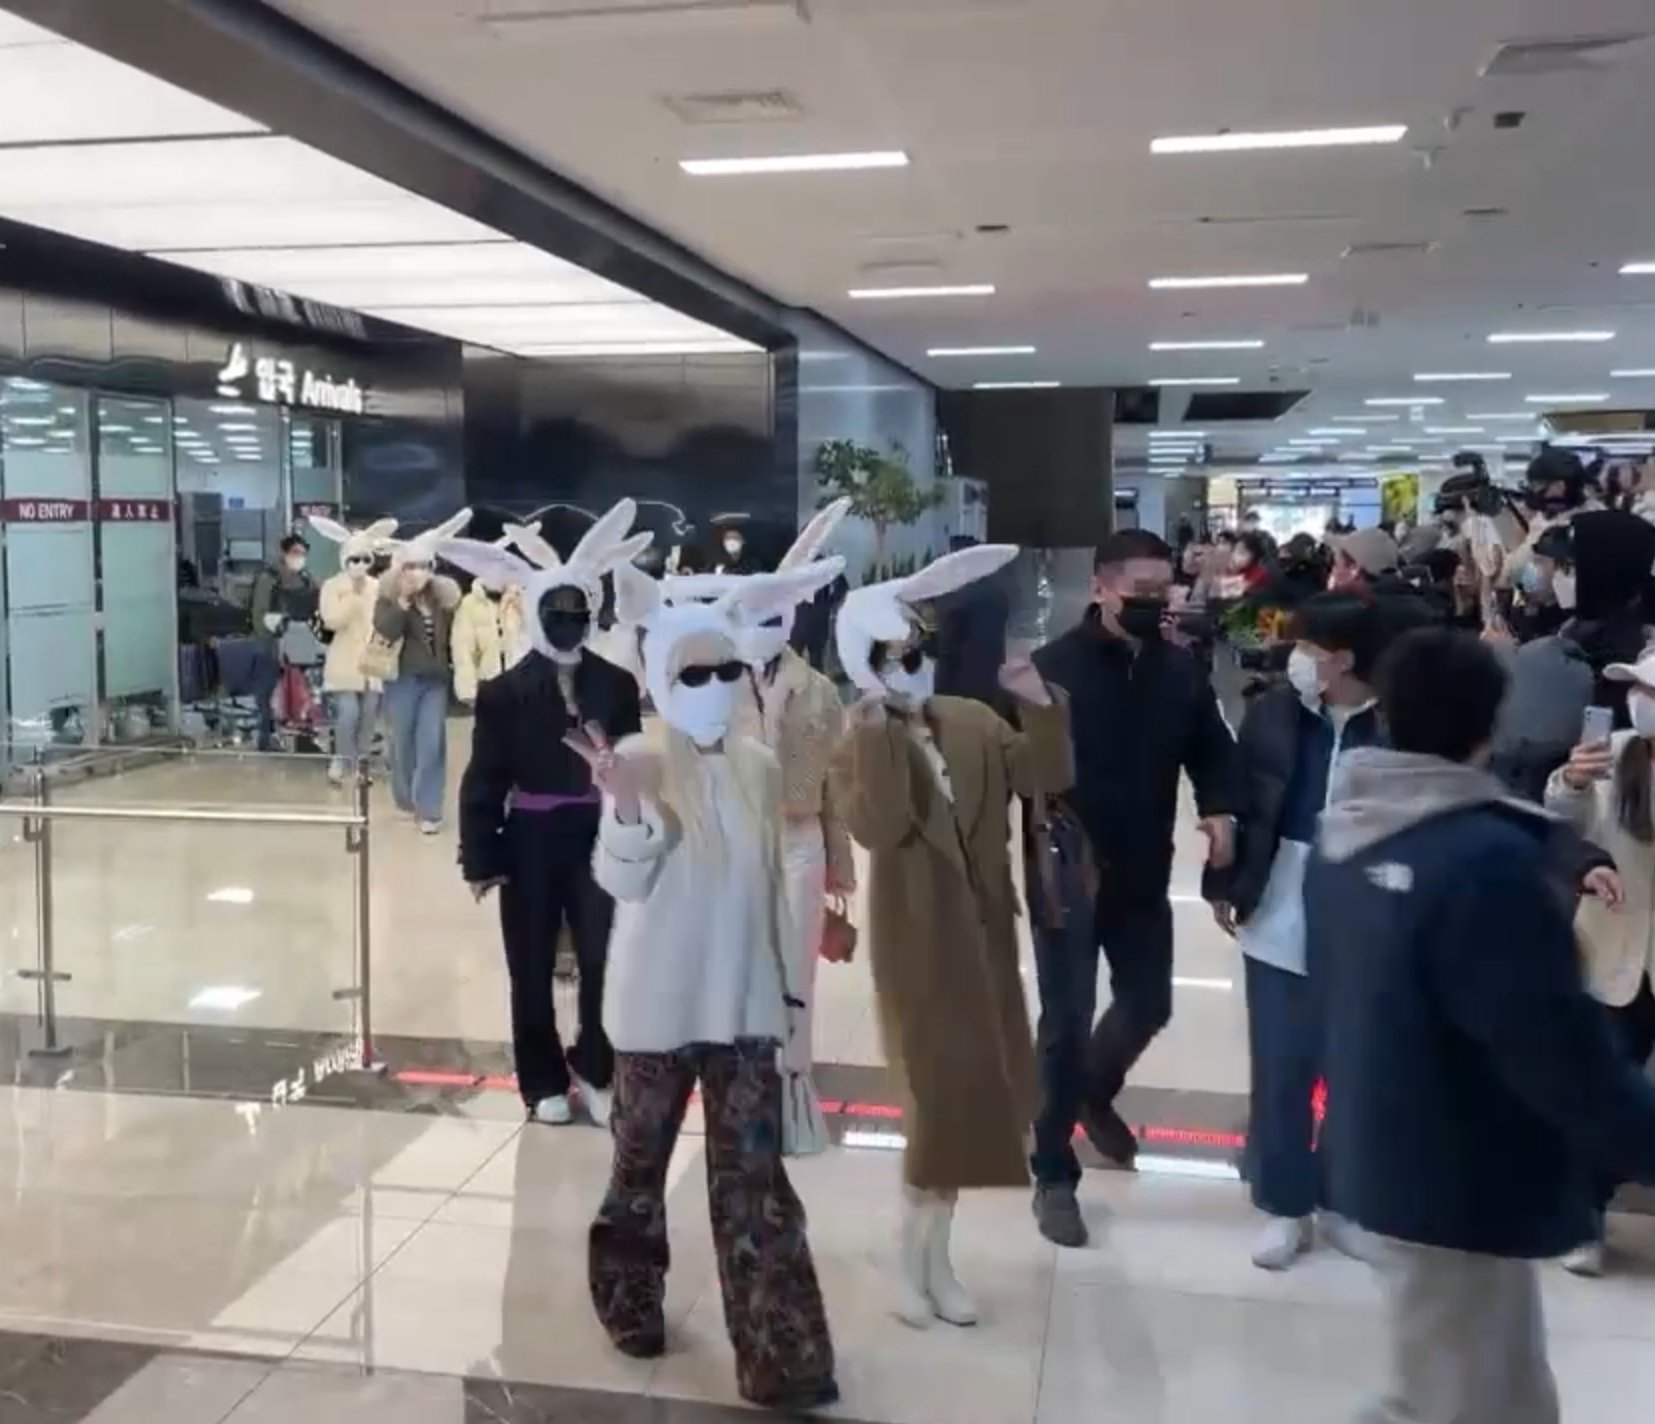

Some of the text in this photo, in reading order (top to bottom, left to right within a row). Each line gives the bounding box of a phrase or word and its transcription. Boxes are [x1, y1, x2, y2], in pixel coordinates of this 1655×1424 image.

[256, 358, 295, 404] 입국
[301, 370, 362, 415] Arrivals
[19, 503, 74, 520] NO ENTRY
